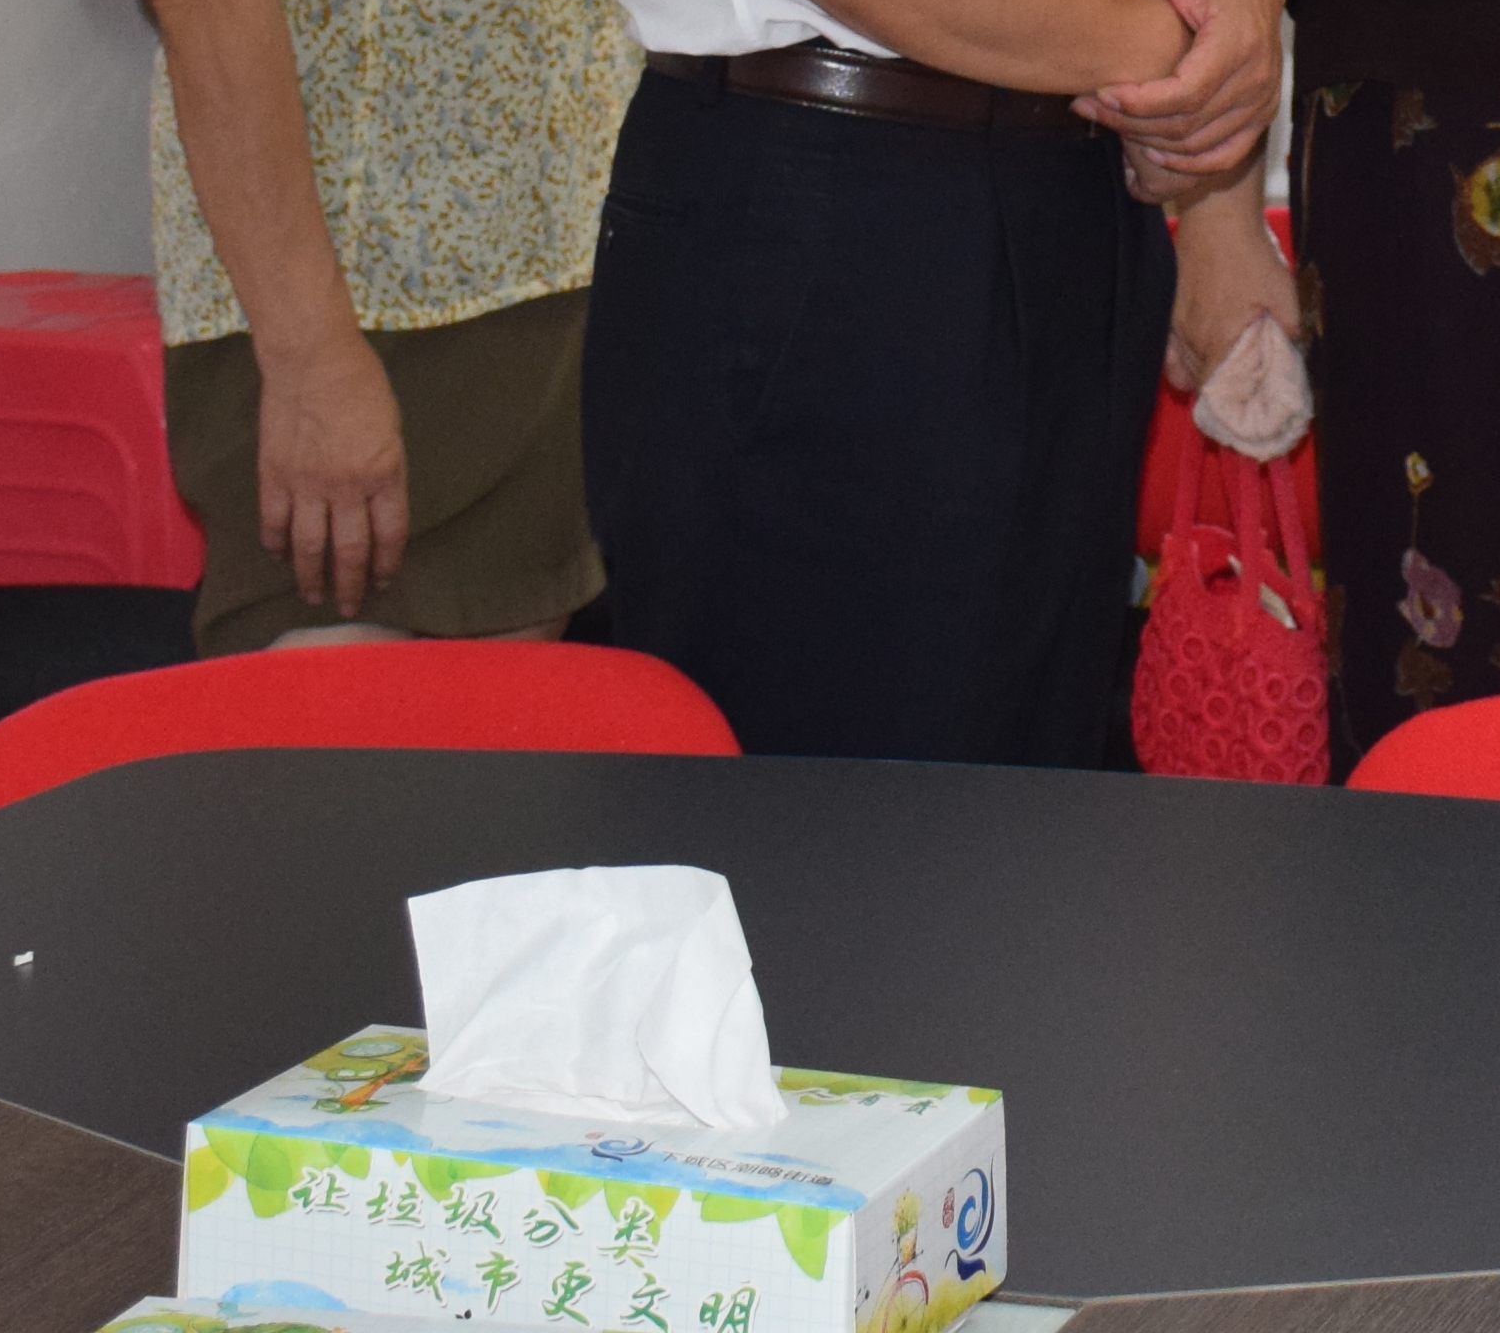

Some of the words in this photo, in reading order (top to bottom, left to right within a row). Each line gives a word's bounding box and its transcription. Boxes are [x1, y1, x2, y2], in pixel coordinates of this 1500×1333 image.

[292, 1169, 657, 1266] 让垃圾分类
[385, 1241, 757, 1333] 城市更文明
